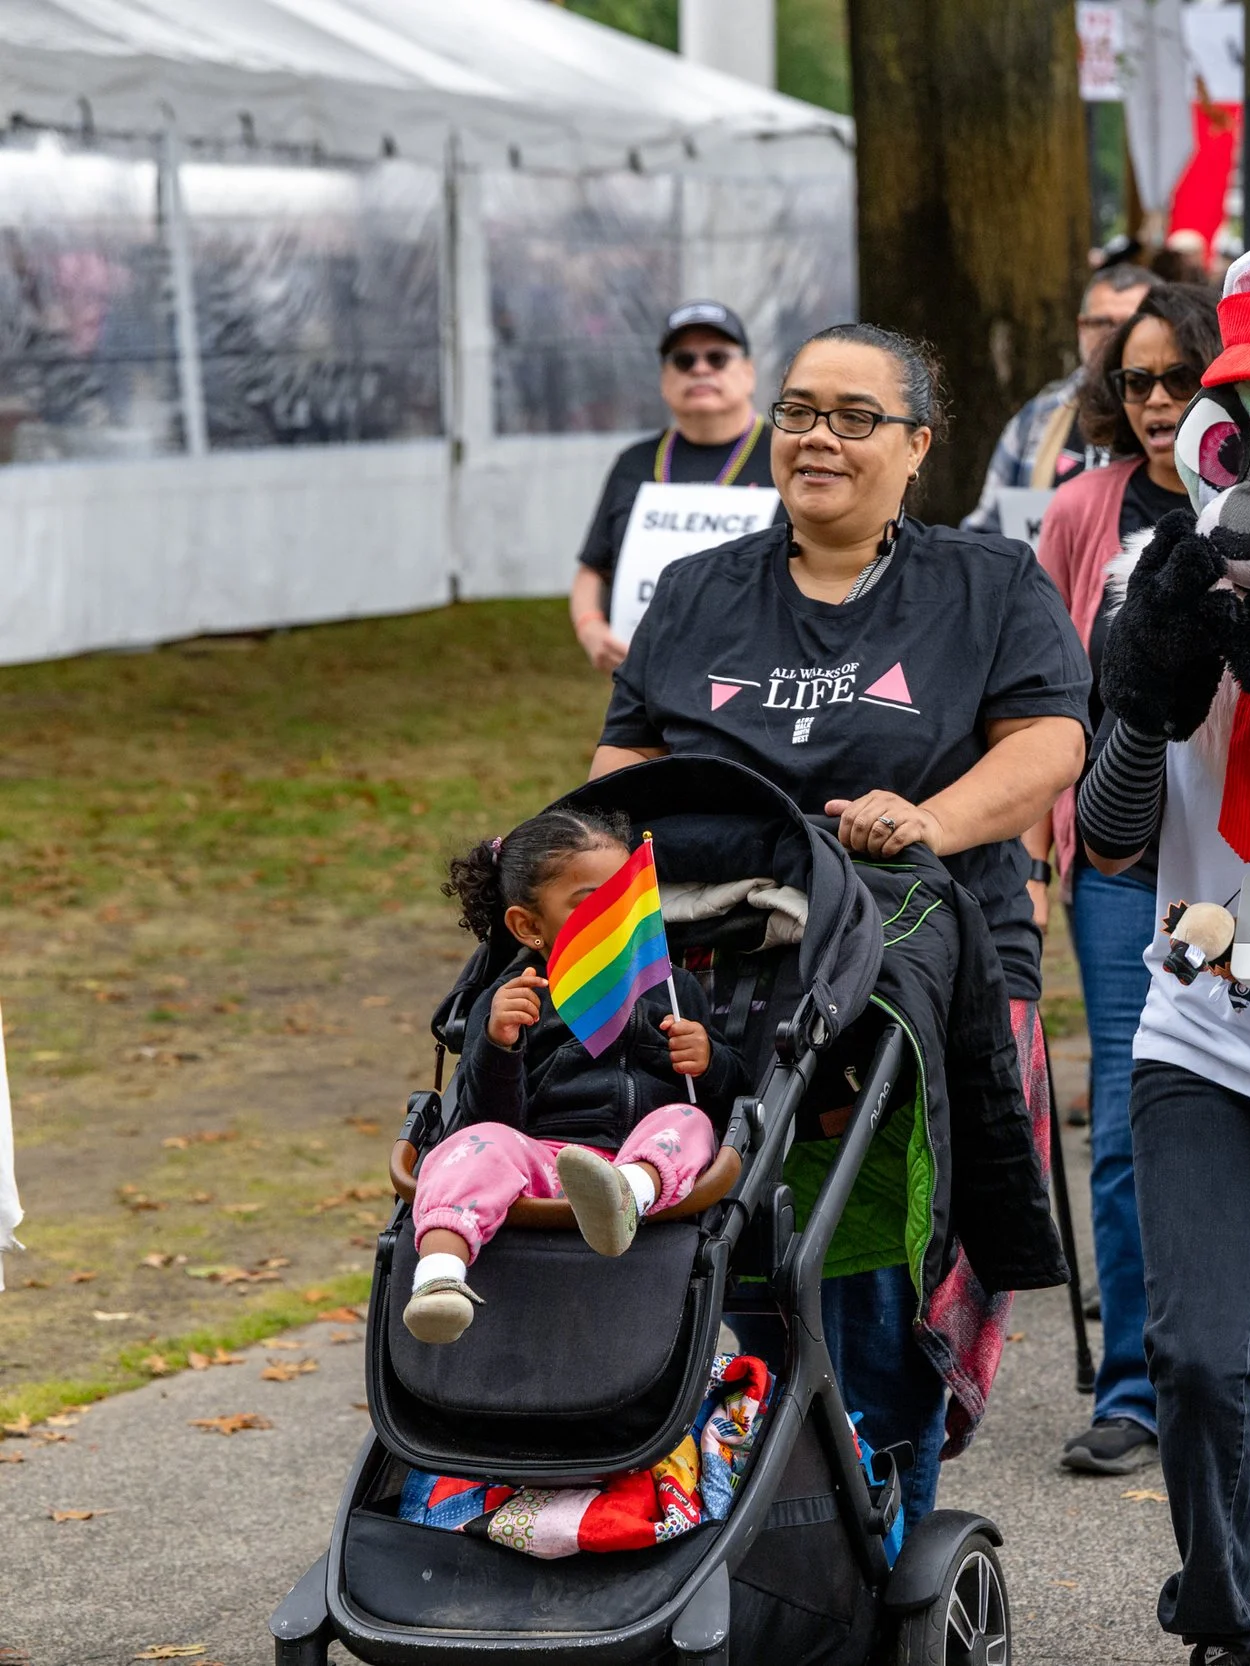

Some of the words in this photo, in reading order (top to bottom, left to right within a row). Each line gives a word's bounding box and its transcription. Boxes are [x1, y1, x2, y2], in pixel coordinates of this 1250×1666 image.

[643, 509, 758, 533] SILENCE
[770, 667, 797, 680] ALL
[799, 667, 841, 679] WALKS
[841, 662, 860, 674] OF
[763, 675, 856, 710] LIFE
[870, 1081, 891, 1130] nuna
